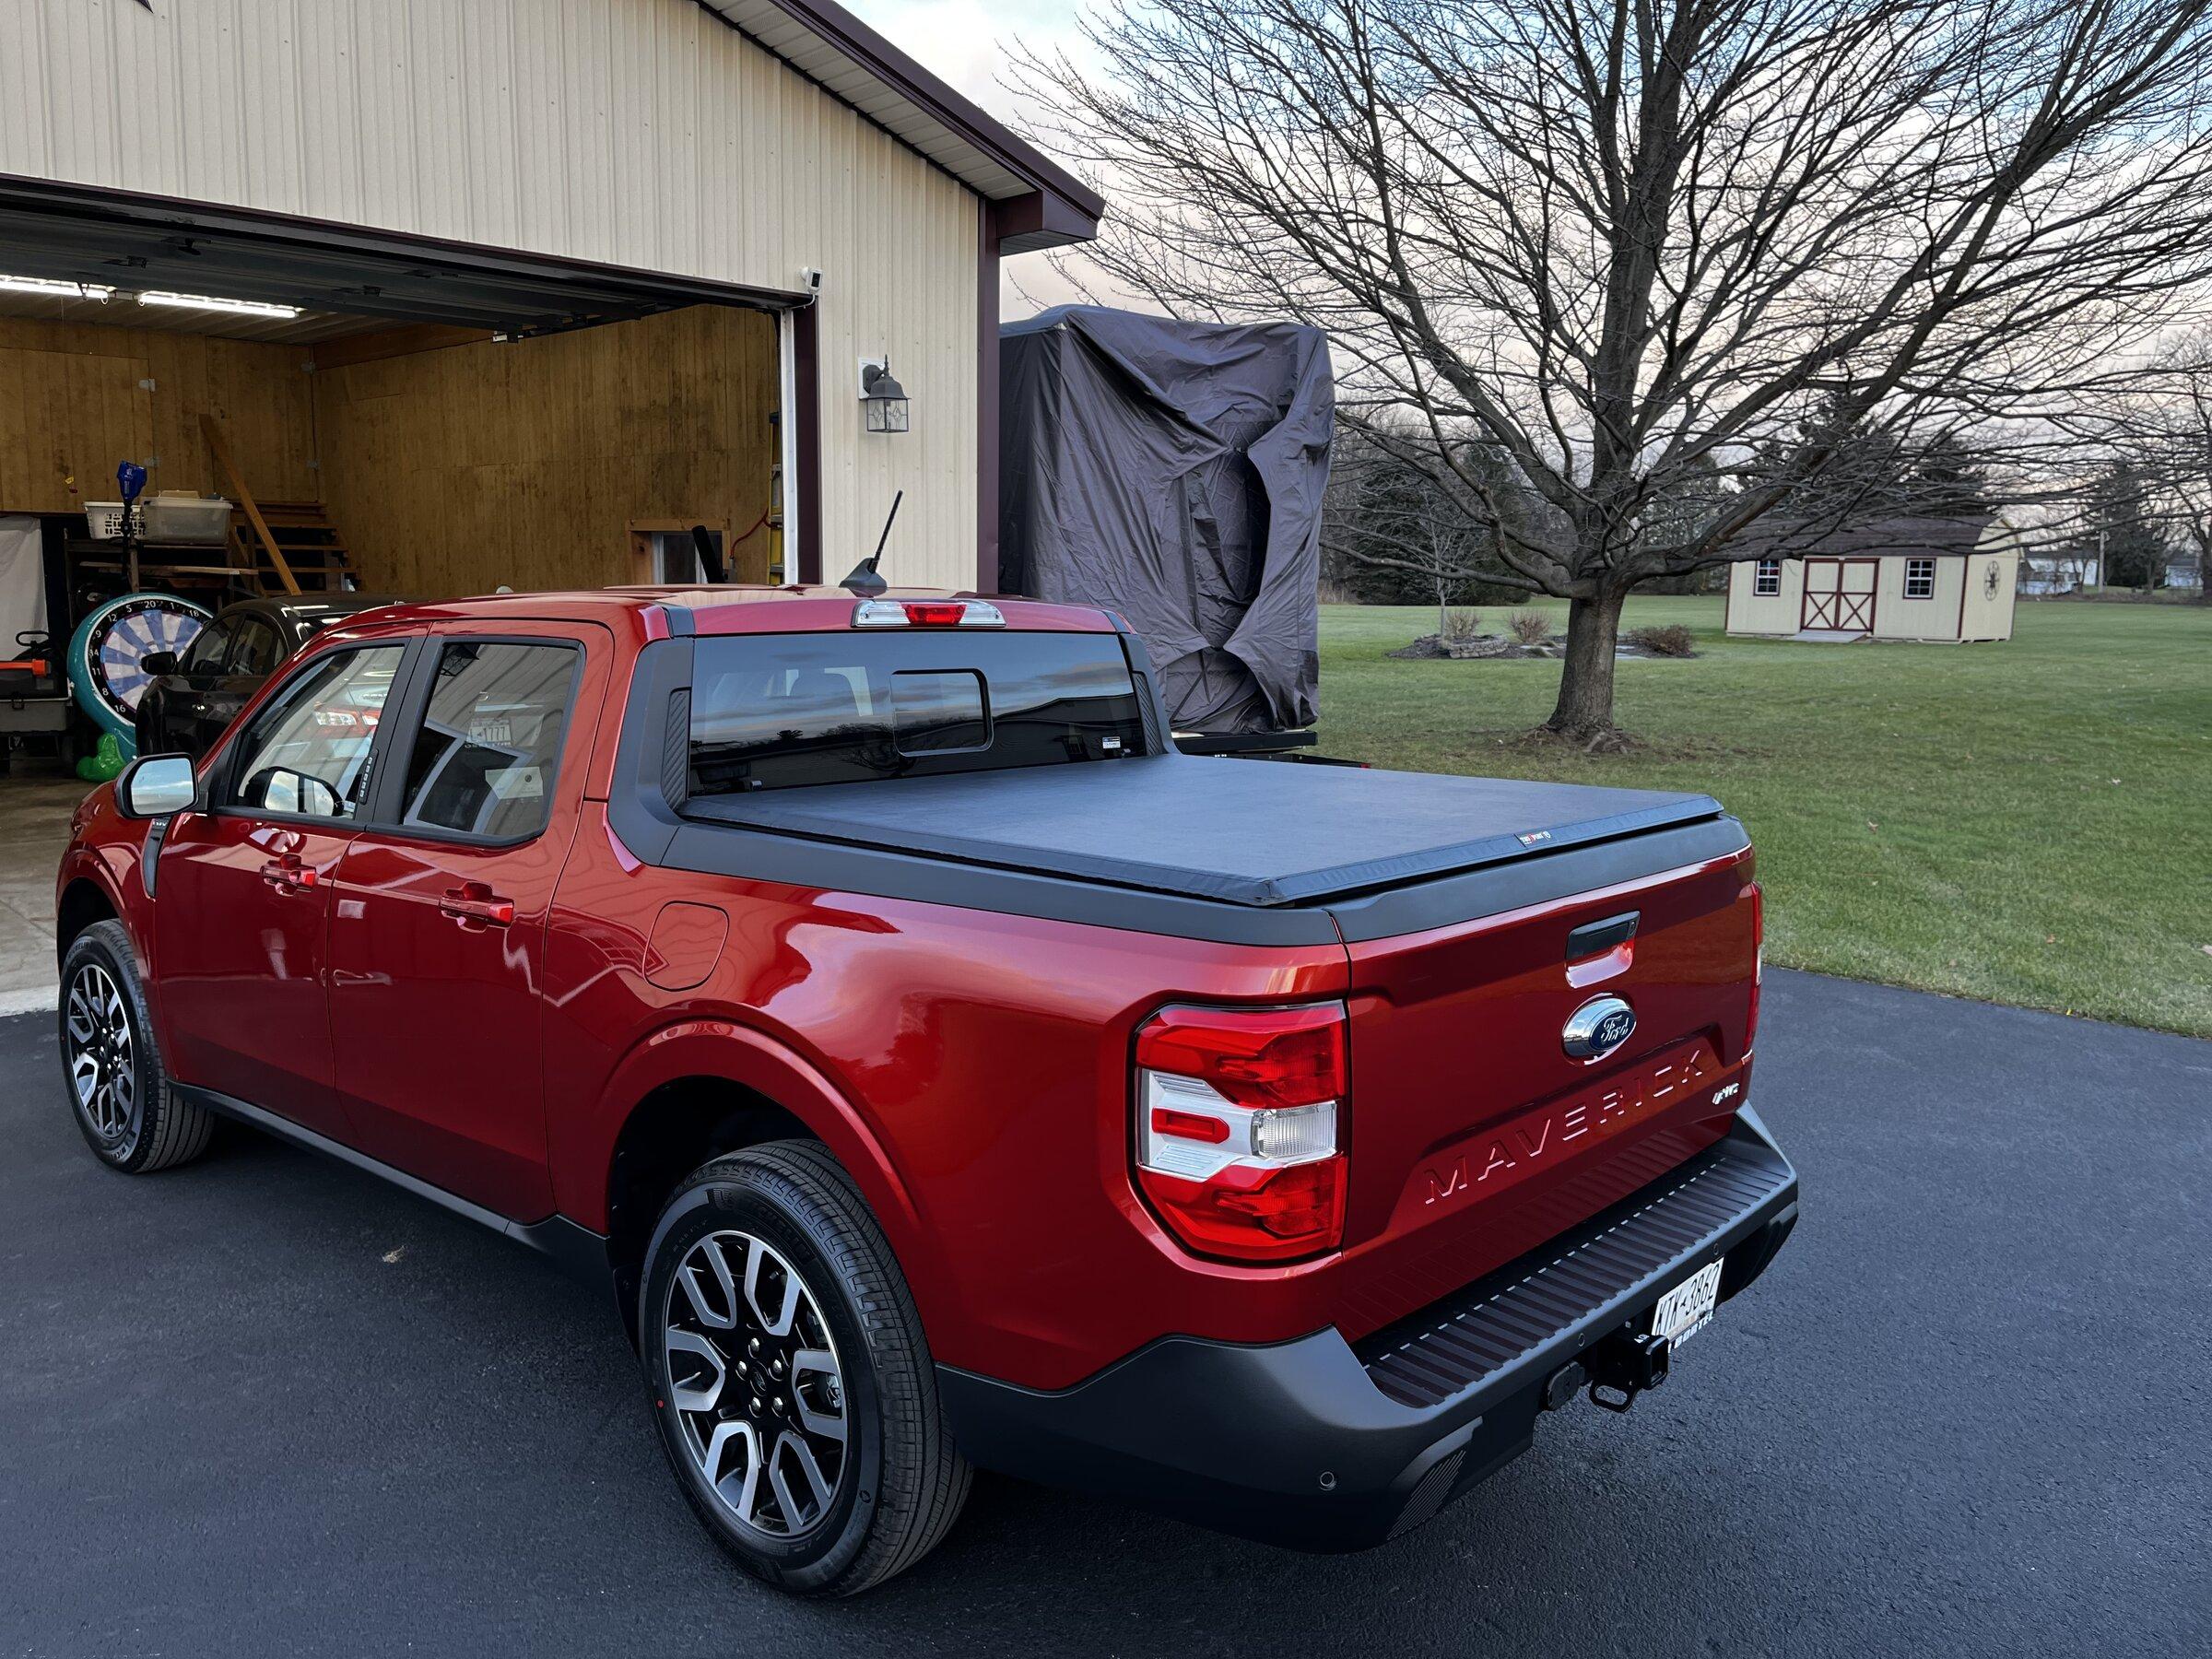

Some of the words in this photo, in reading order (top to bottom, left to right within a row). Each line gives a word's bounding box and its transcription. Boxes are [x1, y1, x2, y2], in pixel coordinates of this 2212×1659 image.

[125, 605, 133, 613] 5
[145, 600, 157, 609] 20
[170, 602, 175, 610] 1
[107, 613, 117, 622] 12
[189, 609, 199, 618] 18
[96, 629, 102, 638] 9
[92, 667, 100, 676] 11
[101, 688, 109, 696] 8
[114, 704, 126, 713] 16
[1600, 1015, 1630, 1042] Ford
[1424, 1049, 1703, 1206] MAVERICK
